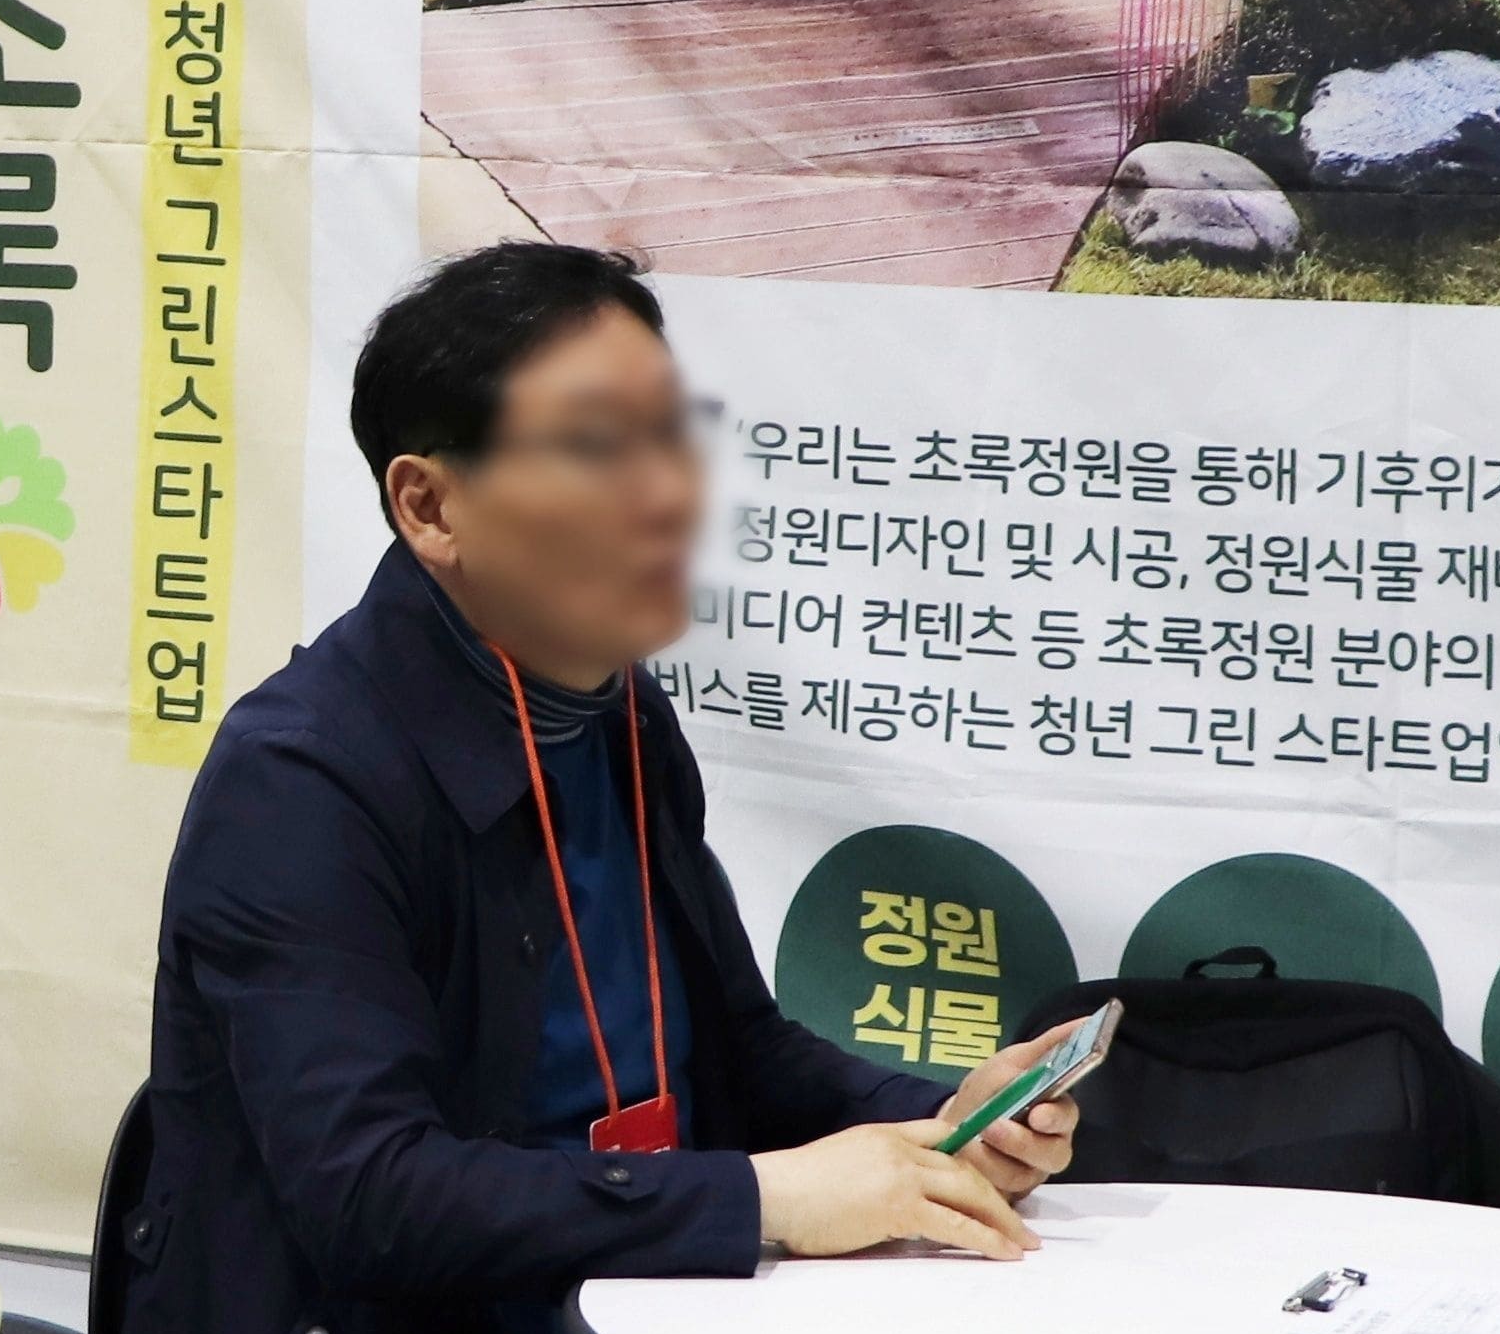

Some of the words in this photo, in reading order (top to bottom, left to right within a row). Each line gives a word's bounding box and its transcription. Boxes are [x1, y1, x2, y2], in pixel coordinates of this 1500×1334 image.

[162, 0, 226, 168] 청년
[908, 428, 1178, 503] 초록정원을
[1189, 445, 1298, 504] 통해
[731, 503, 986, 578] 정원디자인
[1005, 521, 1054, 582] 및
[1071, 526, 1190, 591] 시공,
[1204, 532, 1424, 604] 정원식물
[690, 585, 844, 648] 미디어
[862, 598, 1017, 661] 컨텐츠
[1030, 610, 1085, 671] 등
[1098, 612, 1315, 686] 초록정원
[1330, 628, 1495, 691] 분야의
[650, 660, 788, 731] 비스를
[801, 676, 1015, 751] 제공하는
[1030, 694, 1133, 760] 청년
[1150, 706, 1256, 767] 그린
[858, 888, 1001, 977] 정원
[850, 985, 1003, 1068] 식물
